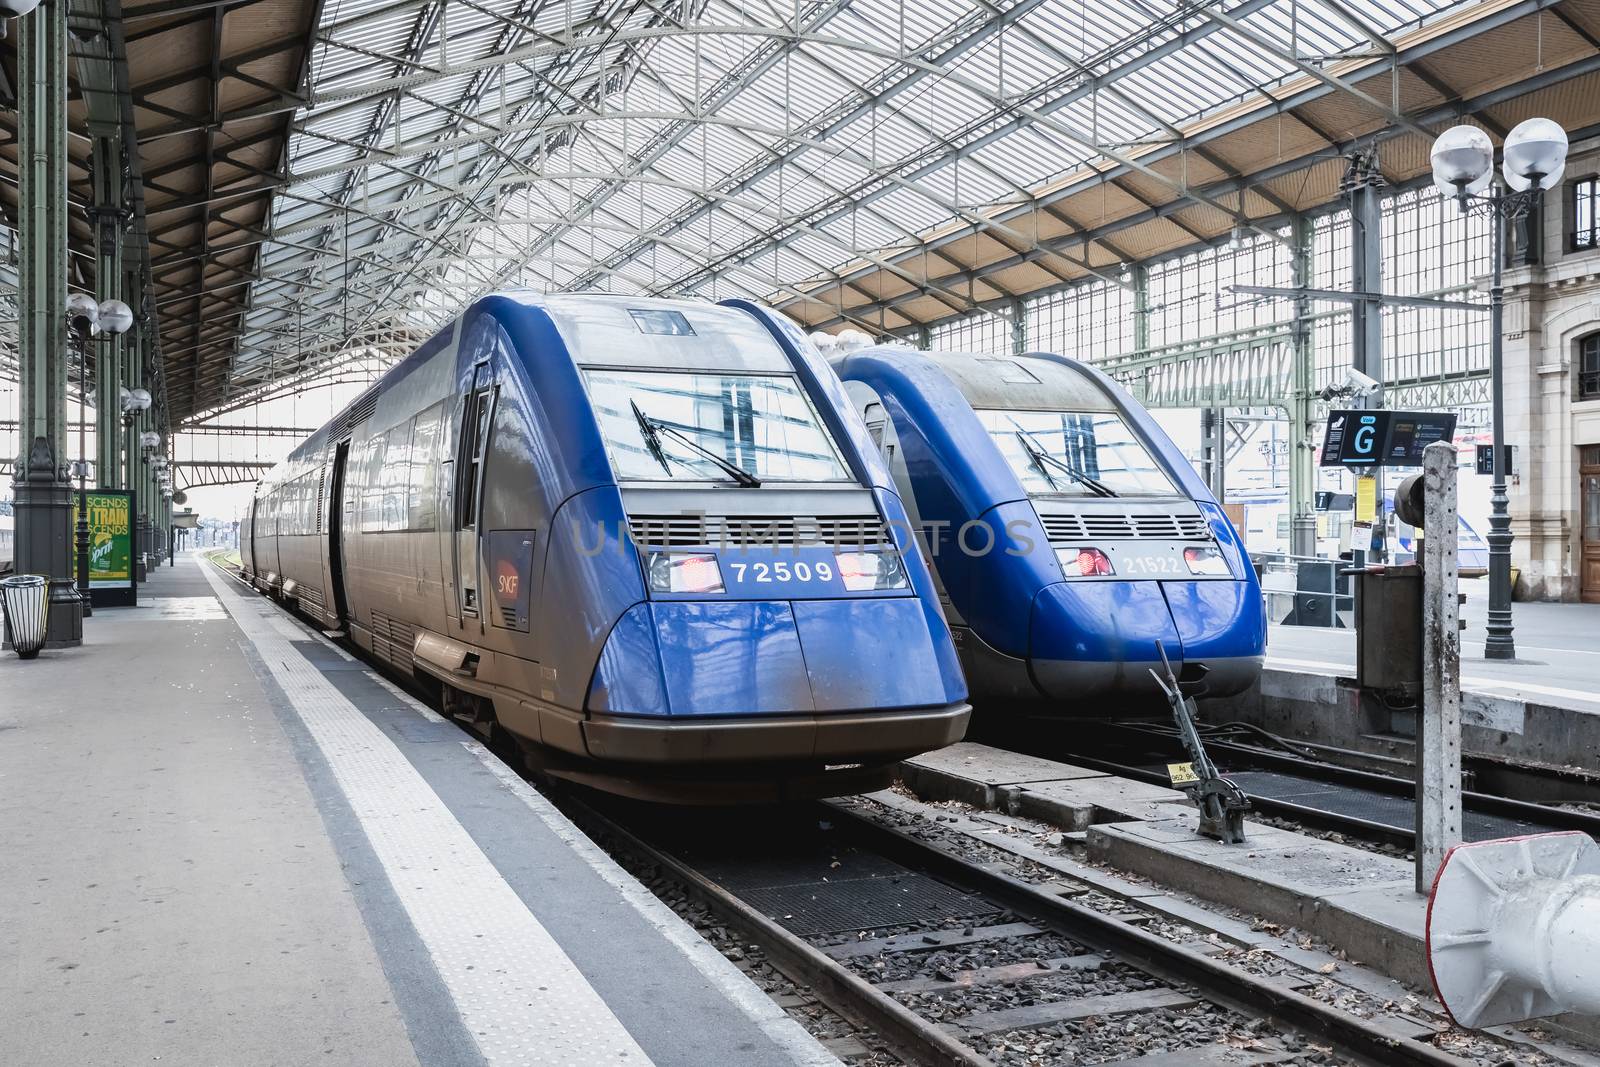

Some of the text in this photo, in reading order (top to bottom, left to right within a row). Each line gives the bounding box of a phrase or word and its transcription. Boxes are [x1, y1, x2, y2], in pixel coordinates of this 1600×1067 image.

[1354, 425, 1376, 454] G
[93, 508, 128, 525] TRAIN
[730, 561, 833, 583] 72509
[1123, 556, 1182, 574] 21522
[498, 575, 518, 593] SNCF
